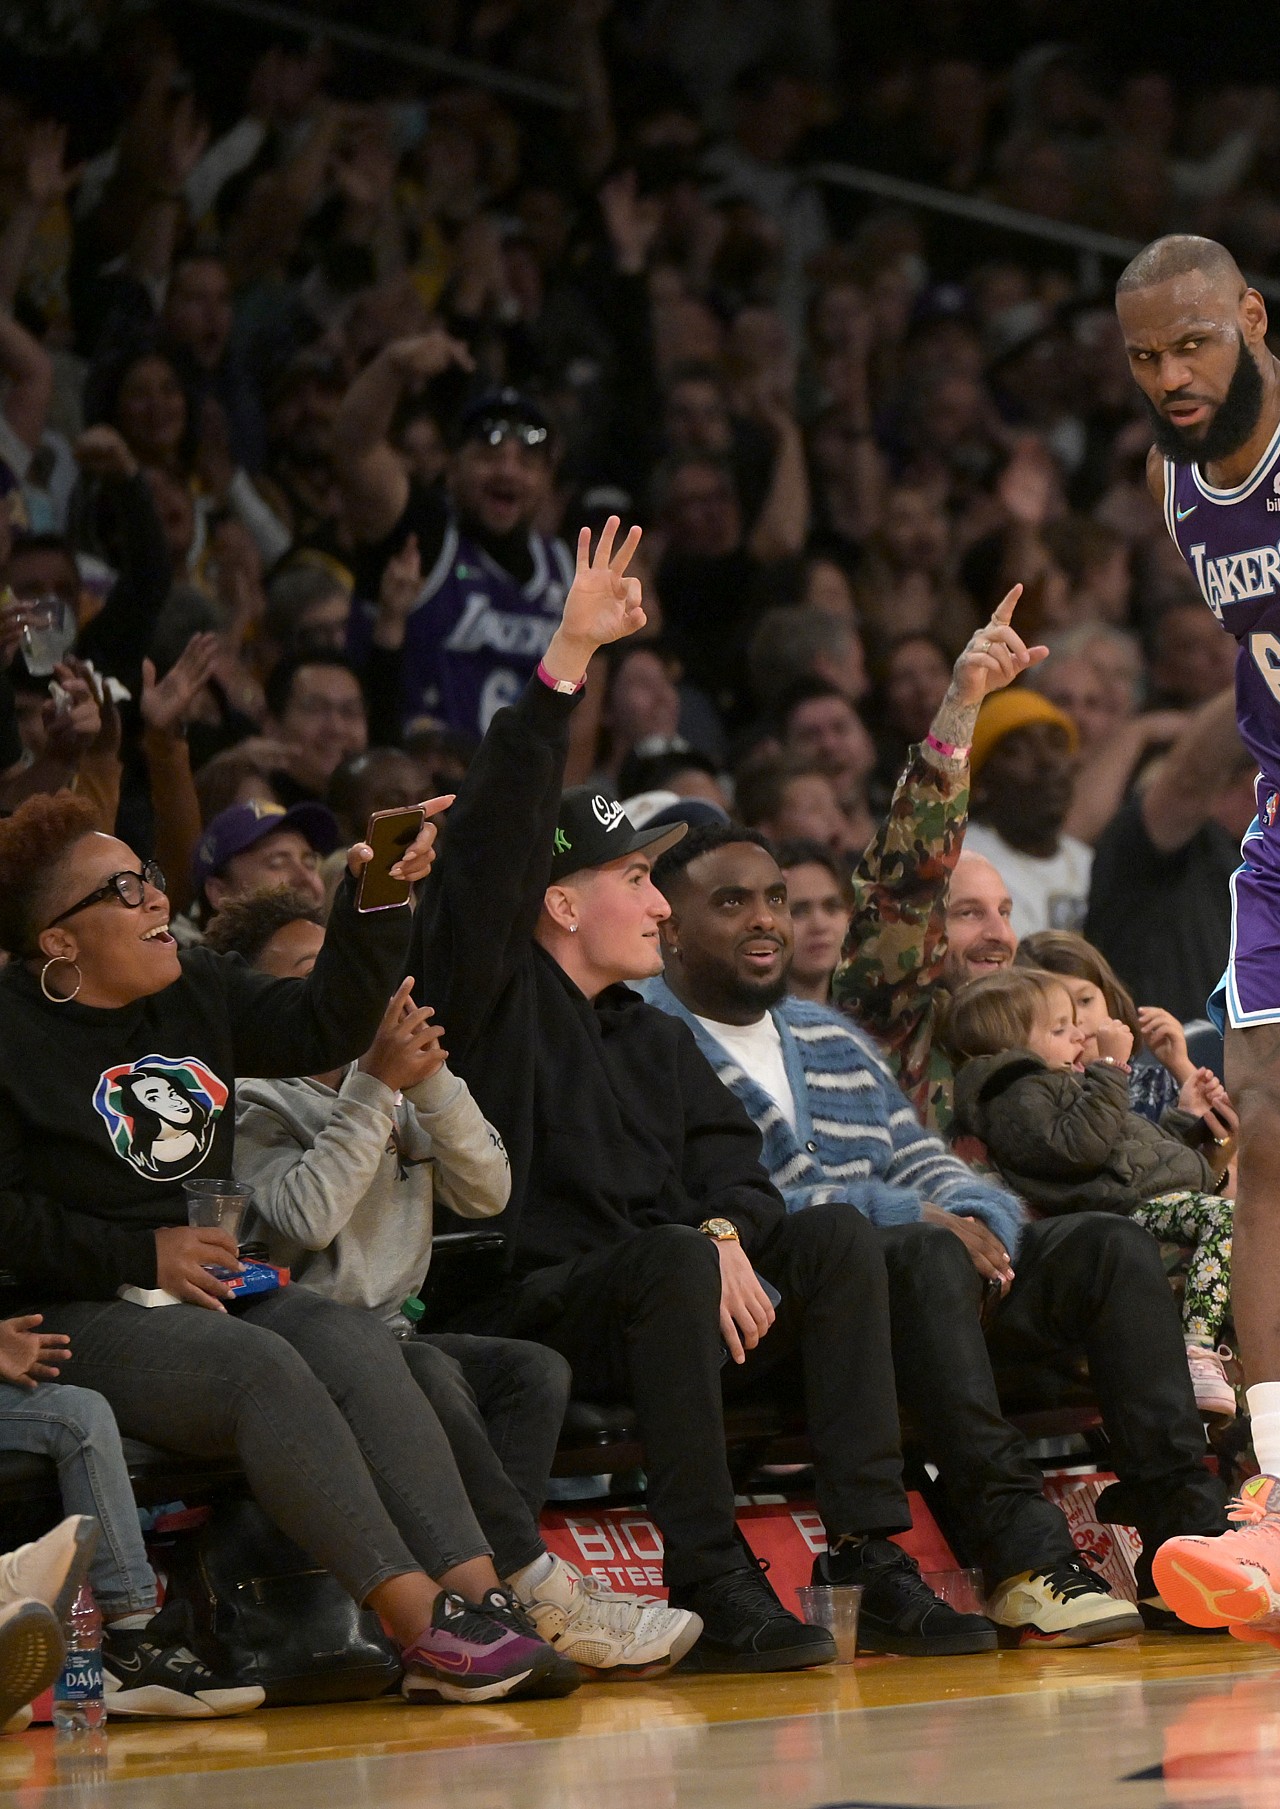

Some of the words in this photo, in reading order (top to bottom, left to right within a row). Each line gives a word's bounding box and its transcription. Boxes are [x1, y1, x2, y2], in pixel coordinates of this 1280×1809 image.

[565, 1518, 664, 1560] BIO
[591, 1566, 663, 1586] STEE
[66, 1668, 103, 1690] DASA
